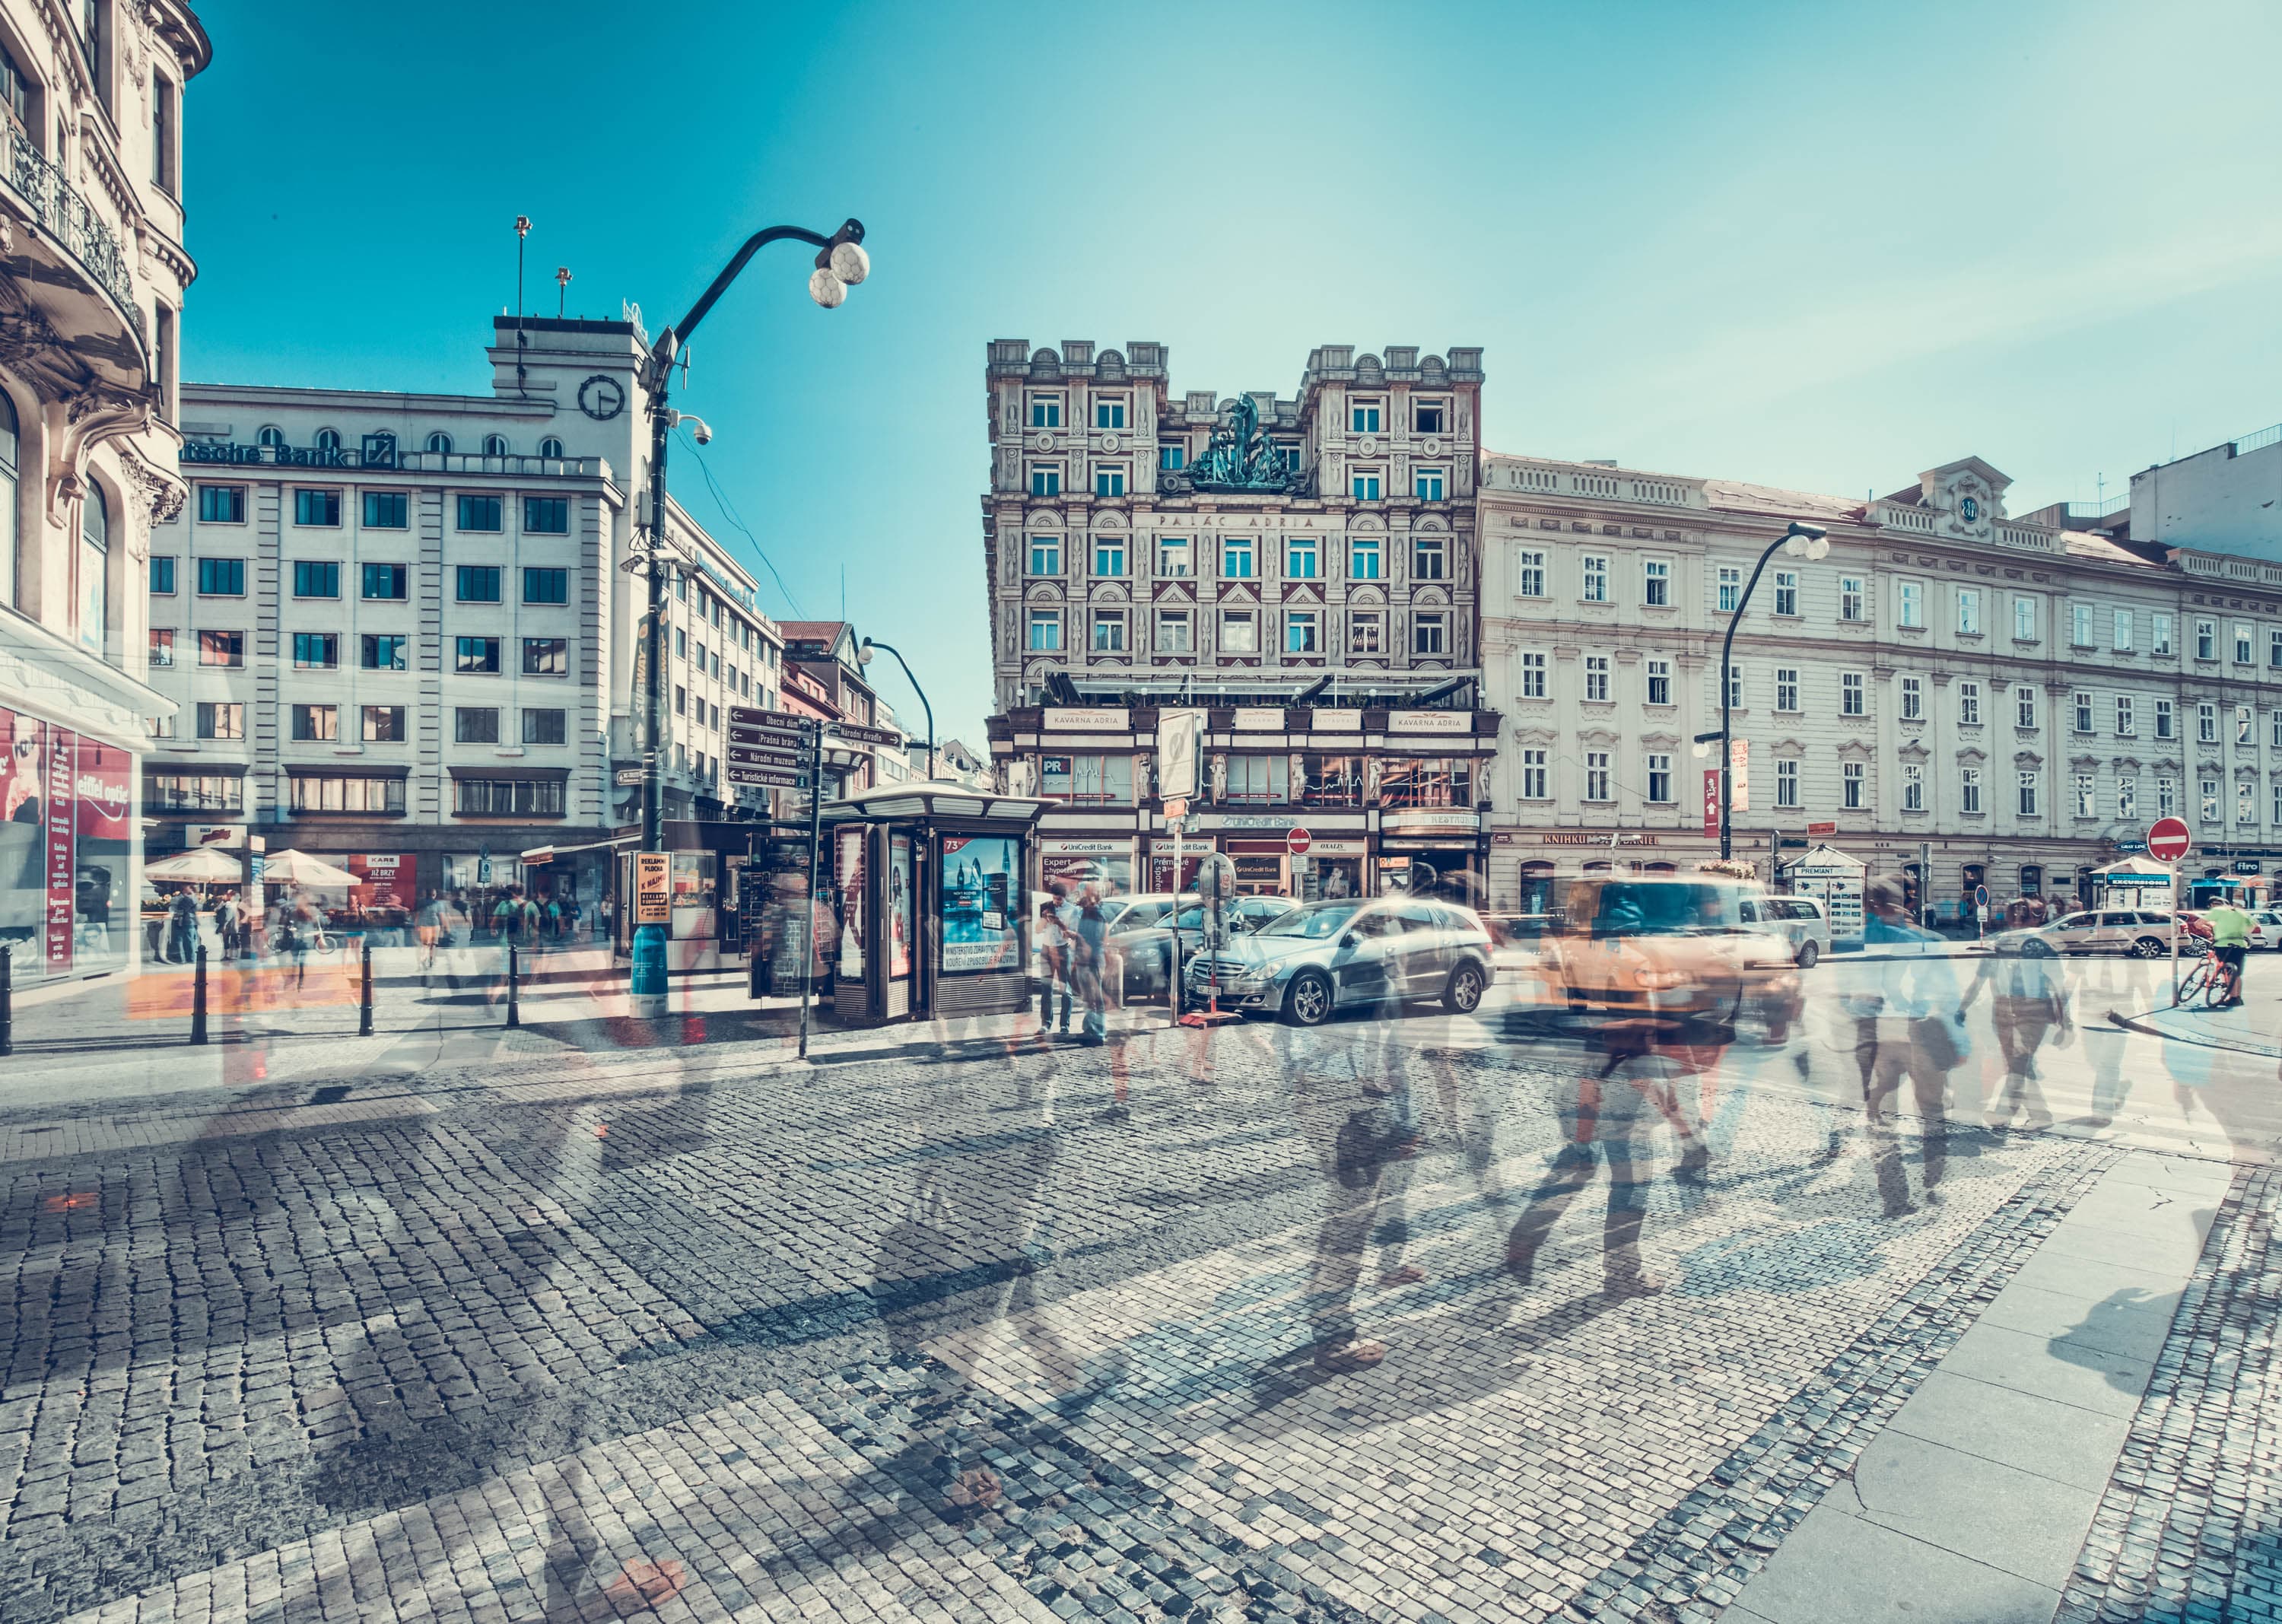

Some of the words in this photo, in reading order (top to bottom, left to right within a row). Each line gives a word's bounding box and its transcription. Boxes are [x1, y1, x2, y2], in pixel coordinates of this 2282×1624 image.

[275, 444, 348, 467] Bank
[1249, 516, 1313, 527] ADRIA
[635, 644, 646, 718] SUBWAY
[767, 716, 785, 726] Obecní
[786, 718, 798, 728] dům
[761, 734, 780, 745] Prašná
[781, 736, 797, 748] brána
[841, 727, 862, 739] Národní
[863, 730, 882, 742] divadlo
[750, 752, 772, 764] Národní
[774, 757, 796, 767] muzeum
[741, 771, 768, 783] Turistické
[768, 774, 796, 786] informace
[78, 775, 103, 799] eiffel
[1233, 816, 1273, 827] UniCredit
[1274, 817, 1298, 828] Bank
[946, 841, 958, 850] 73
[2237, 862, 2258, 870] firo
